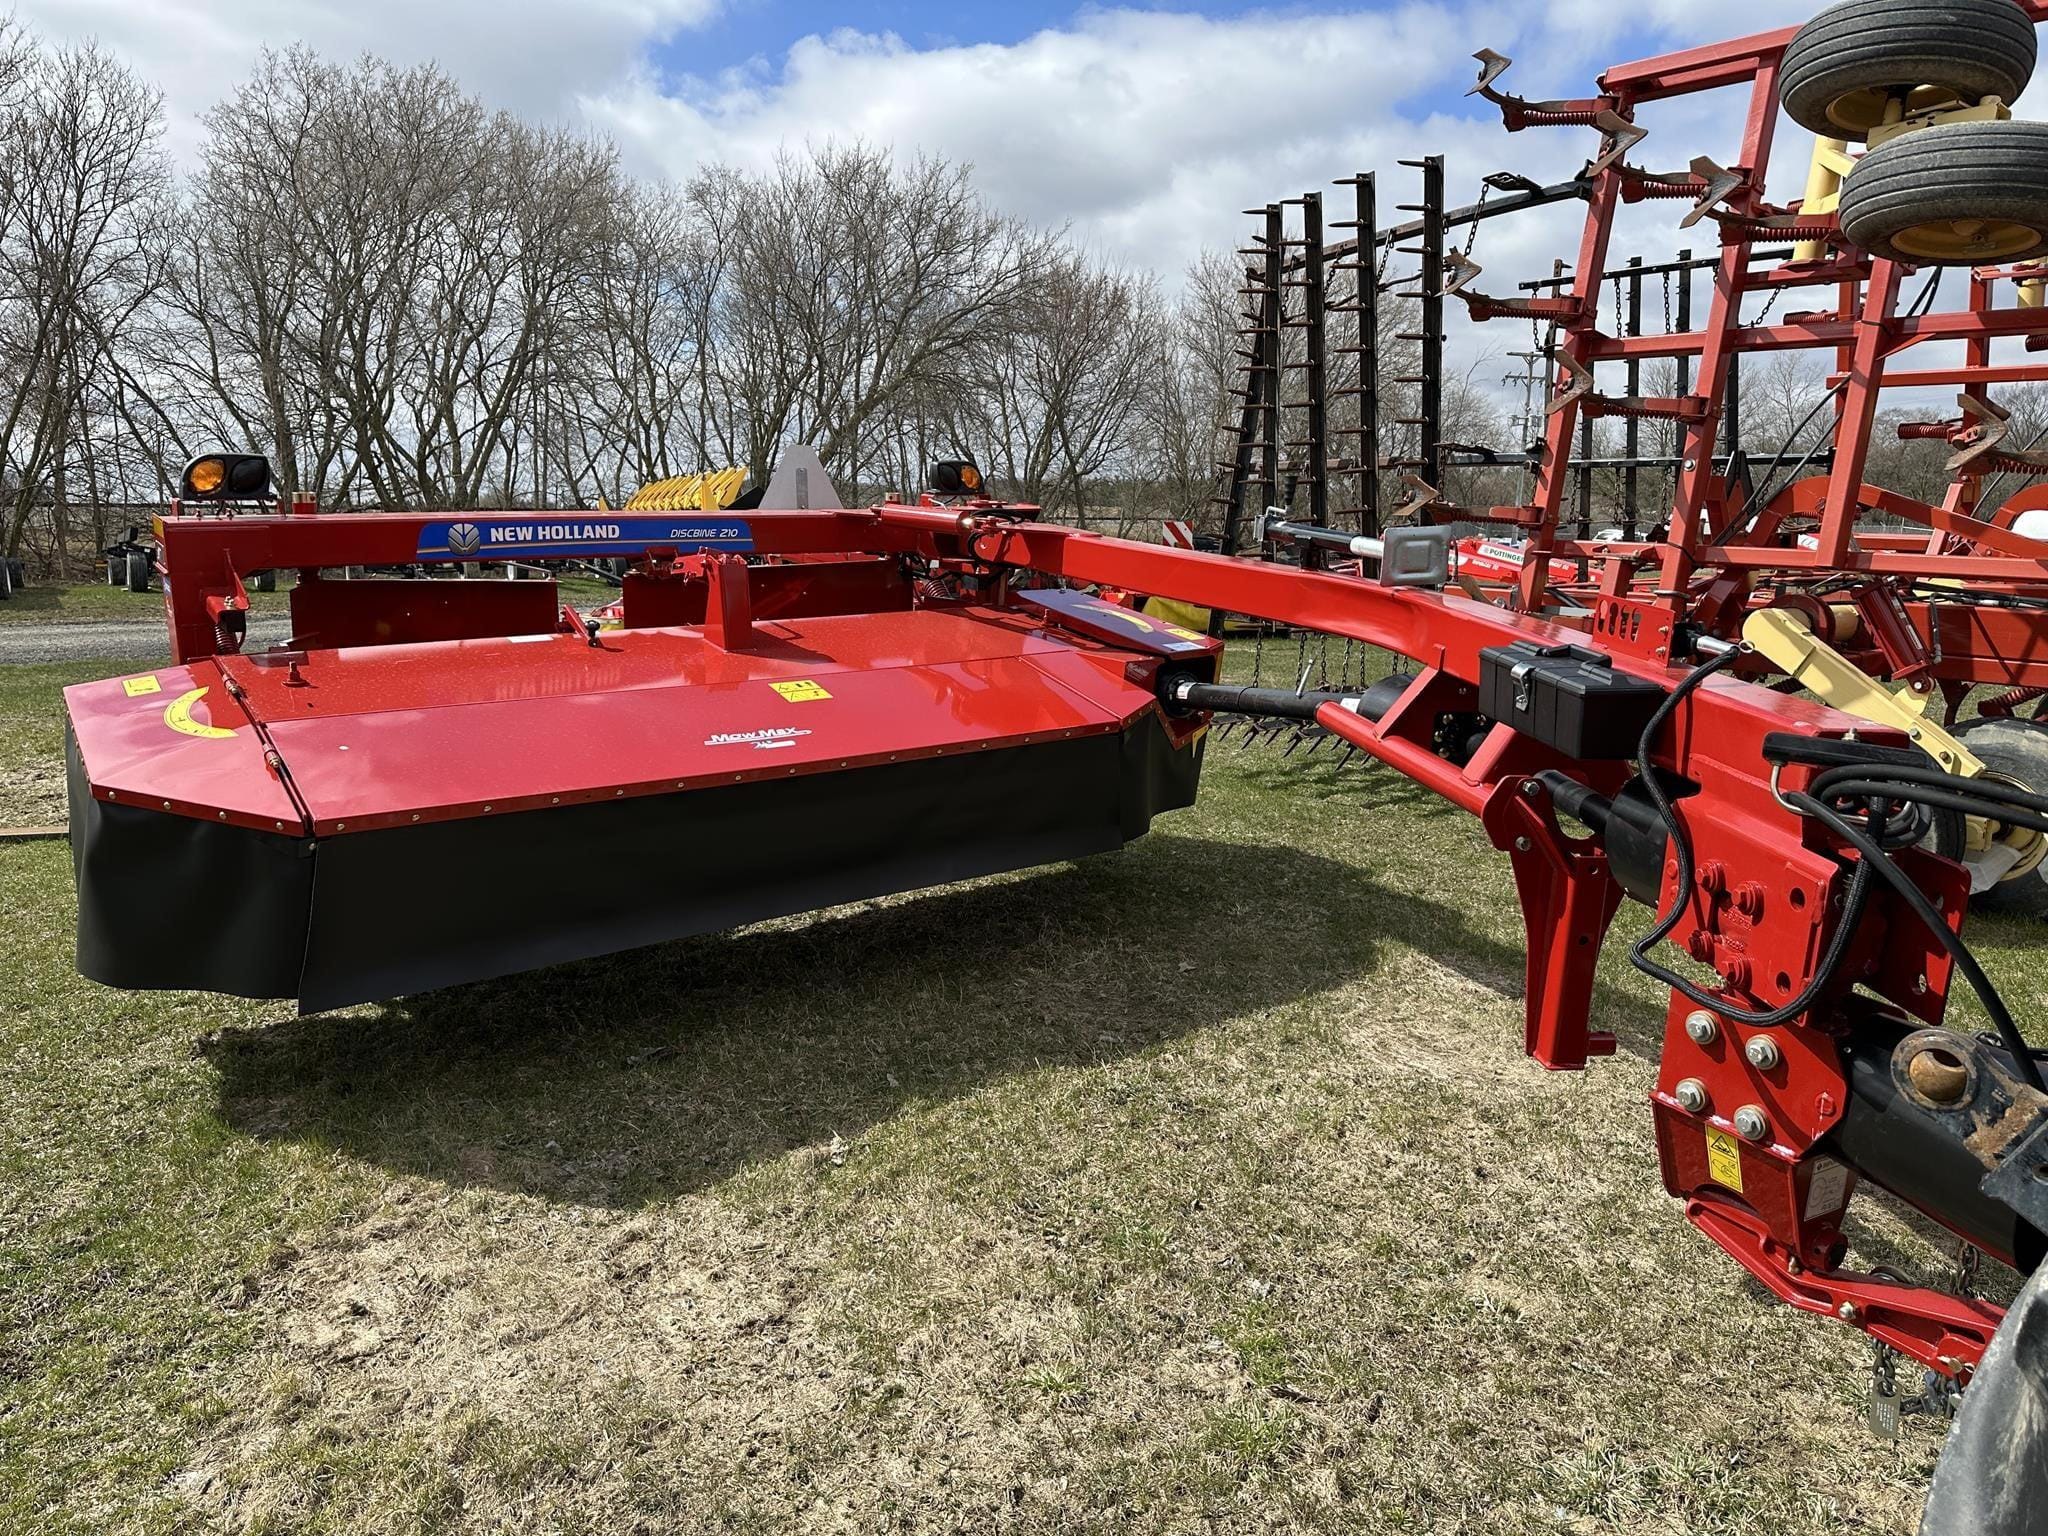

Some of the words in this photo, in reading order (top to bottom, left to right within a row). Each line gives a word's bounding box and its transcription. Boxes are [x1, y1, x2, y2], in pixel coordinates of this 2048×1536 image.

[490, 526, 533, 542] NEW
[537, 524, 620, 540] HOLLAND
[670, 528, 717, 538] DISCBINE
[719, 528, 739, 538] 210
